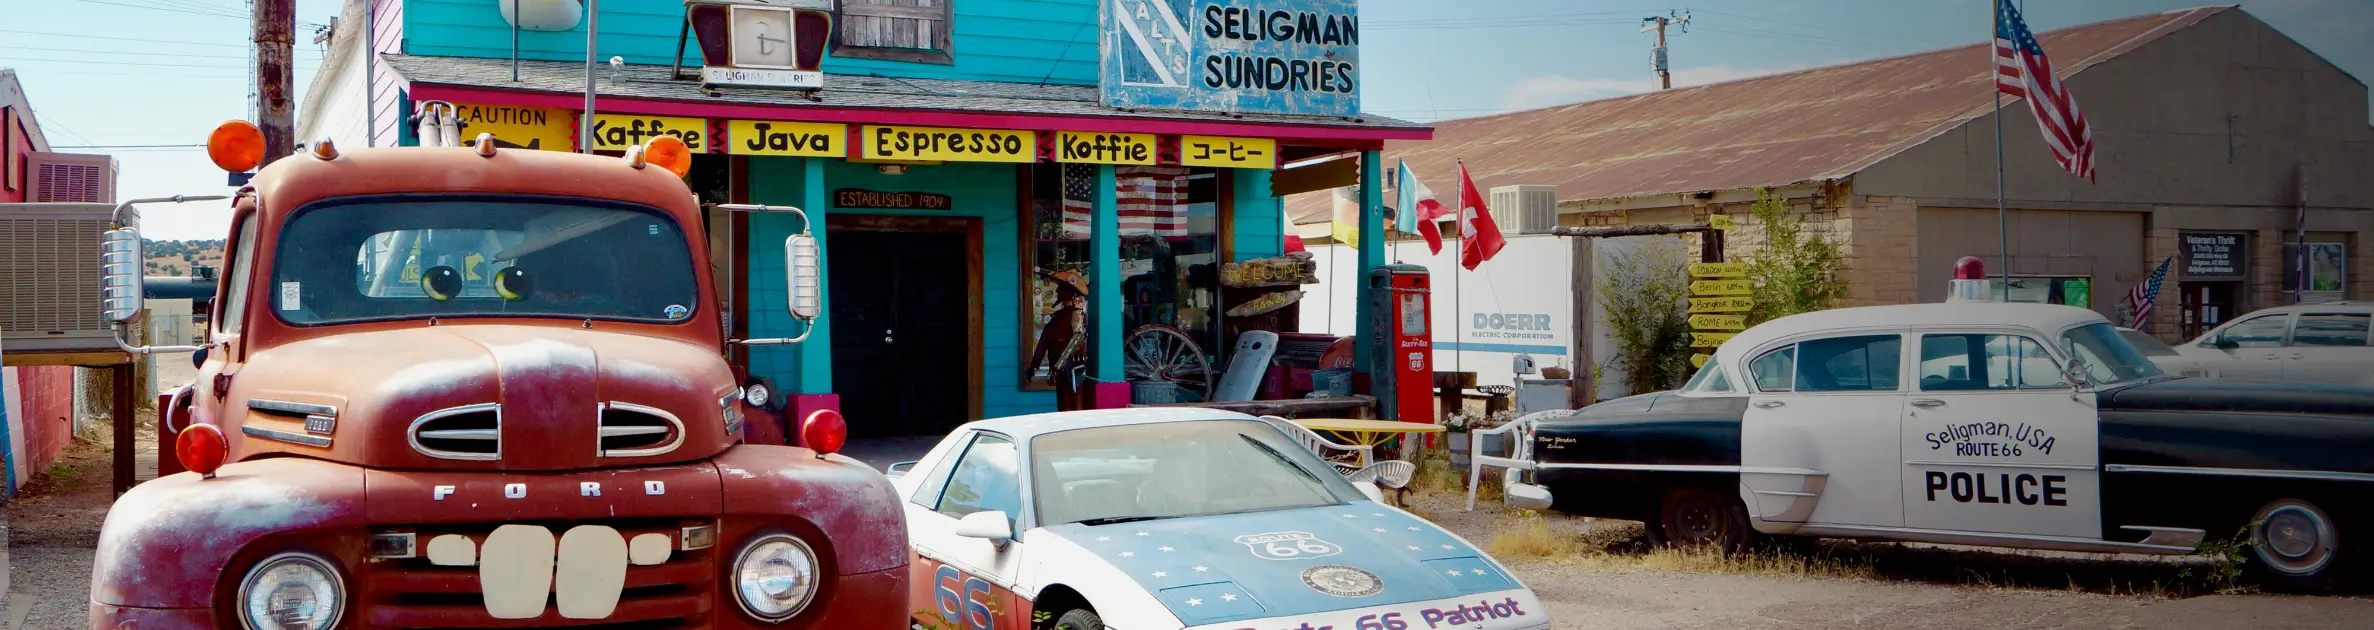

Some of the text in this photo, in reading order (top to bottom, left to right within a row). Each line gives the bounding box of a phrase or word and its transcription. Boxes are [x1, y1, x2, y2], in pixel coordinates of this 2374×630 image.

[1204, 5, 1359, 46] SELIGMAN
[1126, 0, 1186, 75] ALTS
[1204, 55, 1354, 93] SUNDRIES
[455, 105, 547, 126] CAUTION
[746, 122, 830, 152] Java
[875, 127, 1022, 157] Espresso
[1062, 133, 1148, 161] Koffie
[1192, 140, 1263, 161] コーヒー
[840, 191, 945, 208] ESTABLISHED 1904
[2186, 235, 2235, 245] Veteran's Thrift
[1228, 262, 1305, 281] WELCOME
[1699, 282, 1721, 292] Berlin
[1696, 299, 1728, 311] Bangkok
[1473, 312, 1551, 331] DOERR
[1697, 317, 1721, 327] ROME
[1502, 332, 1554, 340] CORPORATION
[1956, 442, 2022, 457] ROUTE 66
[2015, 422, 2056, 456] USA
[433, 480, 665, 501] FORD
[1925, 470, 2068, 507] POLICE
[1247, 532, 1300, 543] ROUTE
[1266, 539, 1331, 557] 66
[934, 564, 994, 630] 66
[1420, 596, 1526, 630] Patriot
